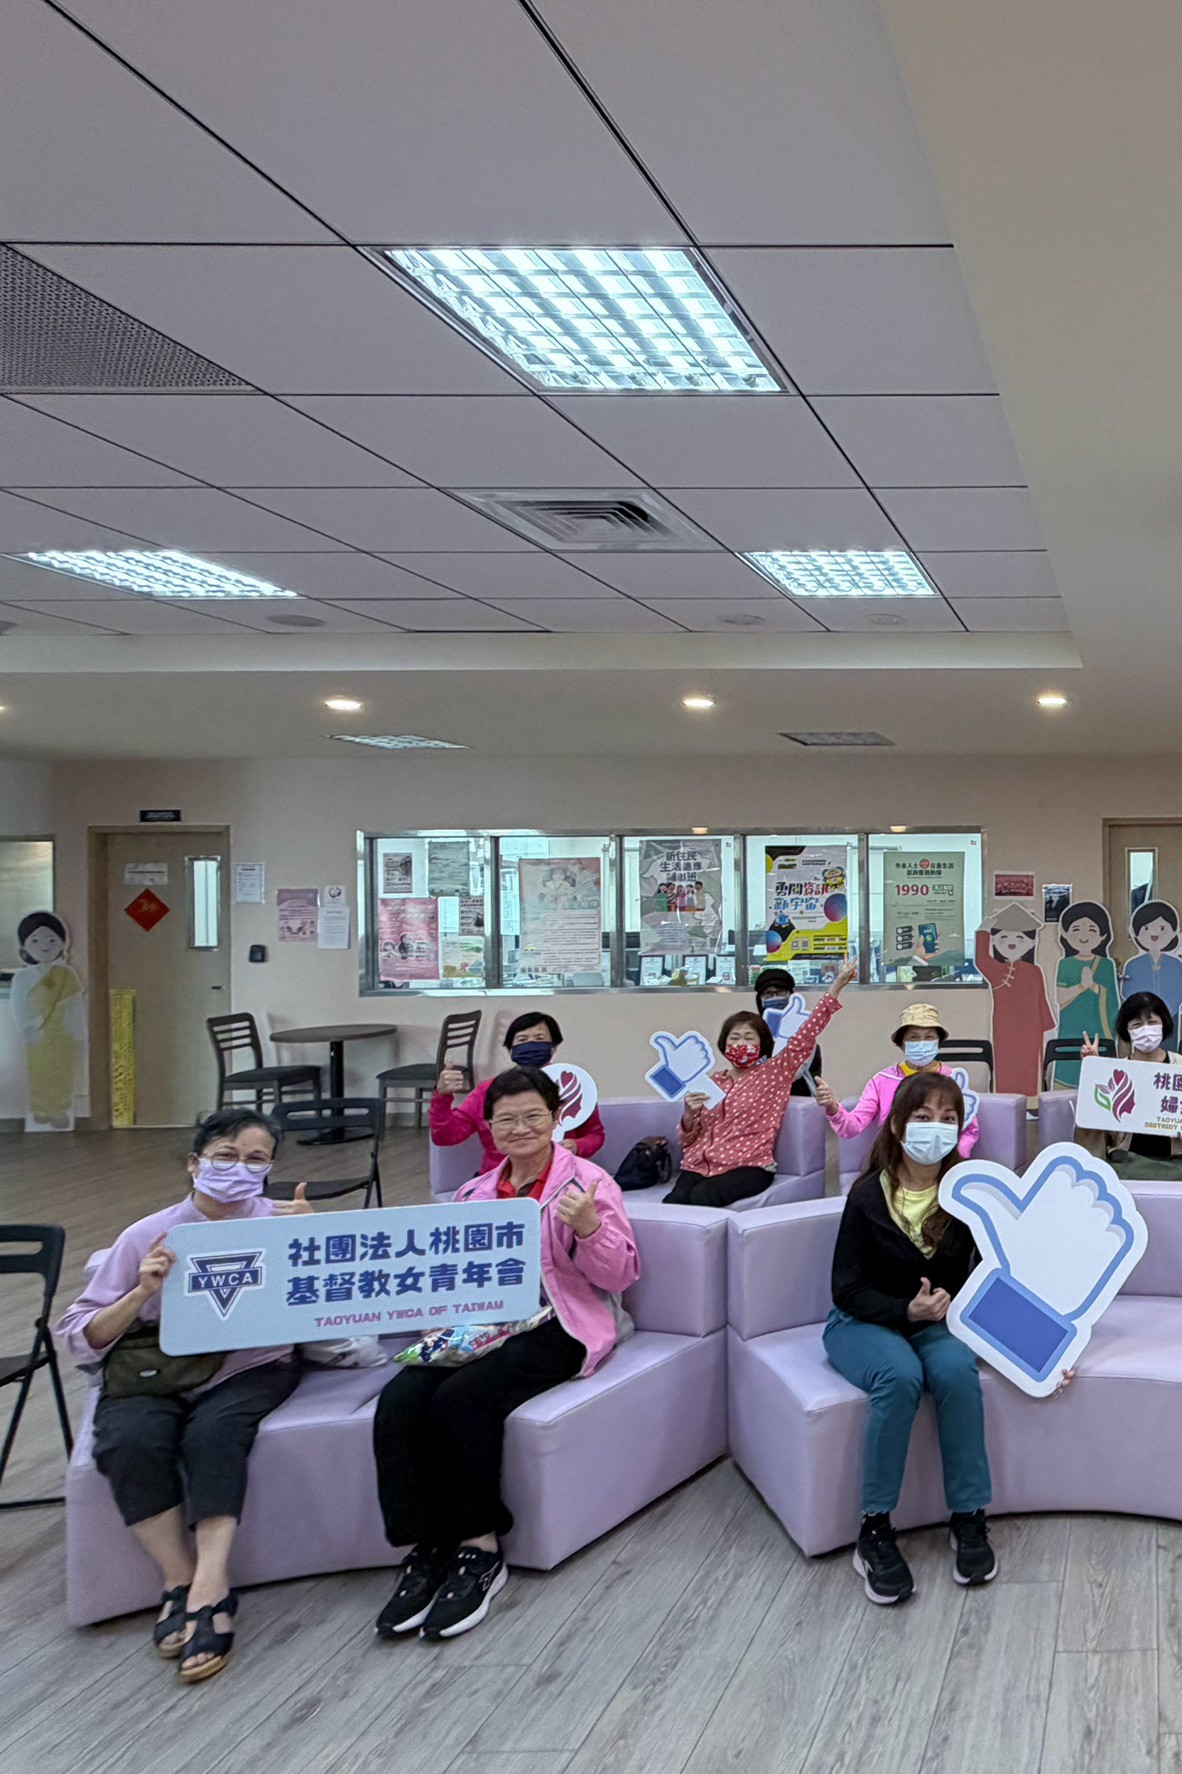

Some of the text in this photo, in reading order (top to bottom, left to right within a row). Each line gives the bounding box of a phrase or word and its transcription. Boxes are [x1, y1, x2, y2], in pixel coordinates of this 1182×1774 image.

[895, 884, 930, 896] 1990
[287, 1220, 526, 1268] 社團法人桃園市
[196, 1270, 254, 1290] YWCA
[286, 1257, 527, 1307] 基督教女青年會
[314, 1311, 381, 1328] TAOYUAN
[387, 1306, 424, 1321] YWCA
[428, 1304, 449, 1317] OF
